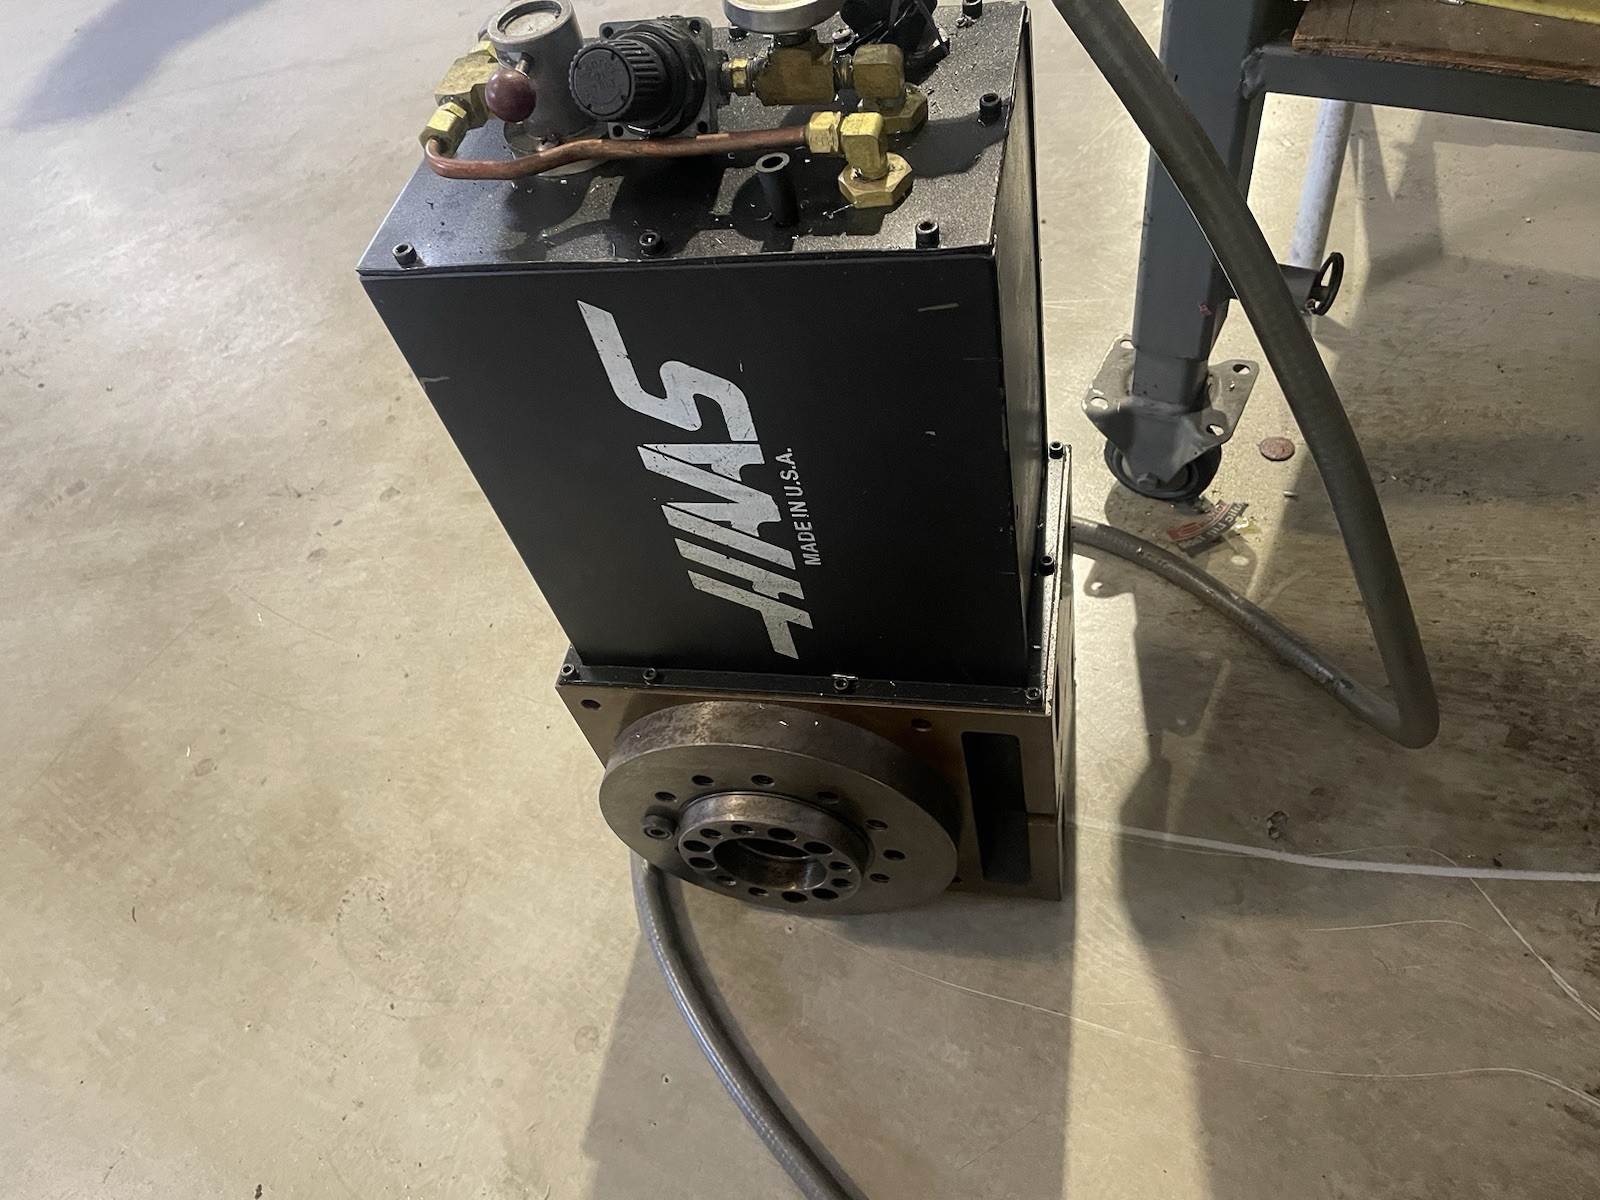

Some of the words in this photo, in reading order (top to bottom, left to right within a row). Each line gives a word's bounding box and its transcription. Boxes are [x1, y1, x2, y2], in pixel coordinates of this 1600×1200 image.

[577, 299, 814, 660] HAAS
[775, 447, 804, 497] U.S.A.
[787, 501, 810, 518] IN
[793, 521, 822, 566] MADE
